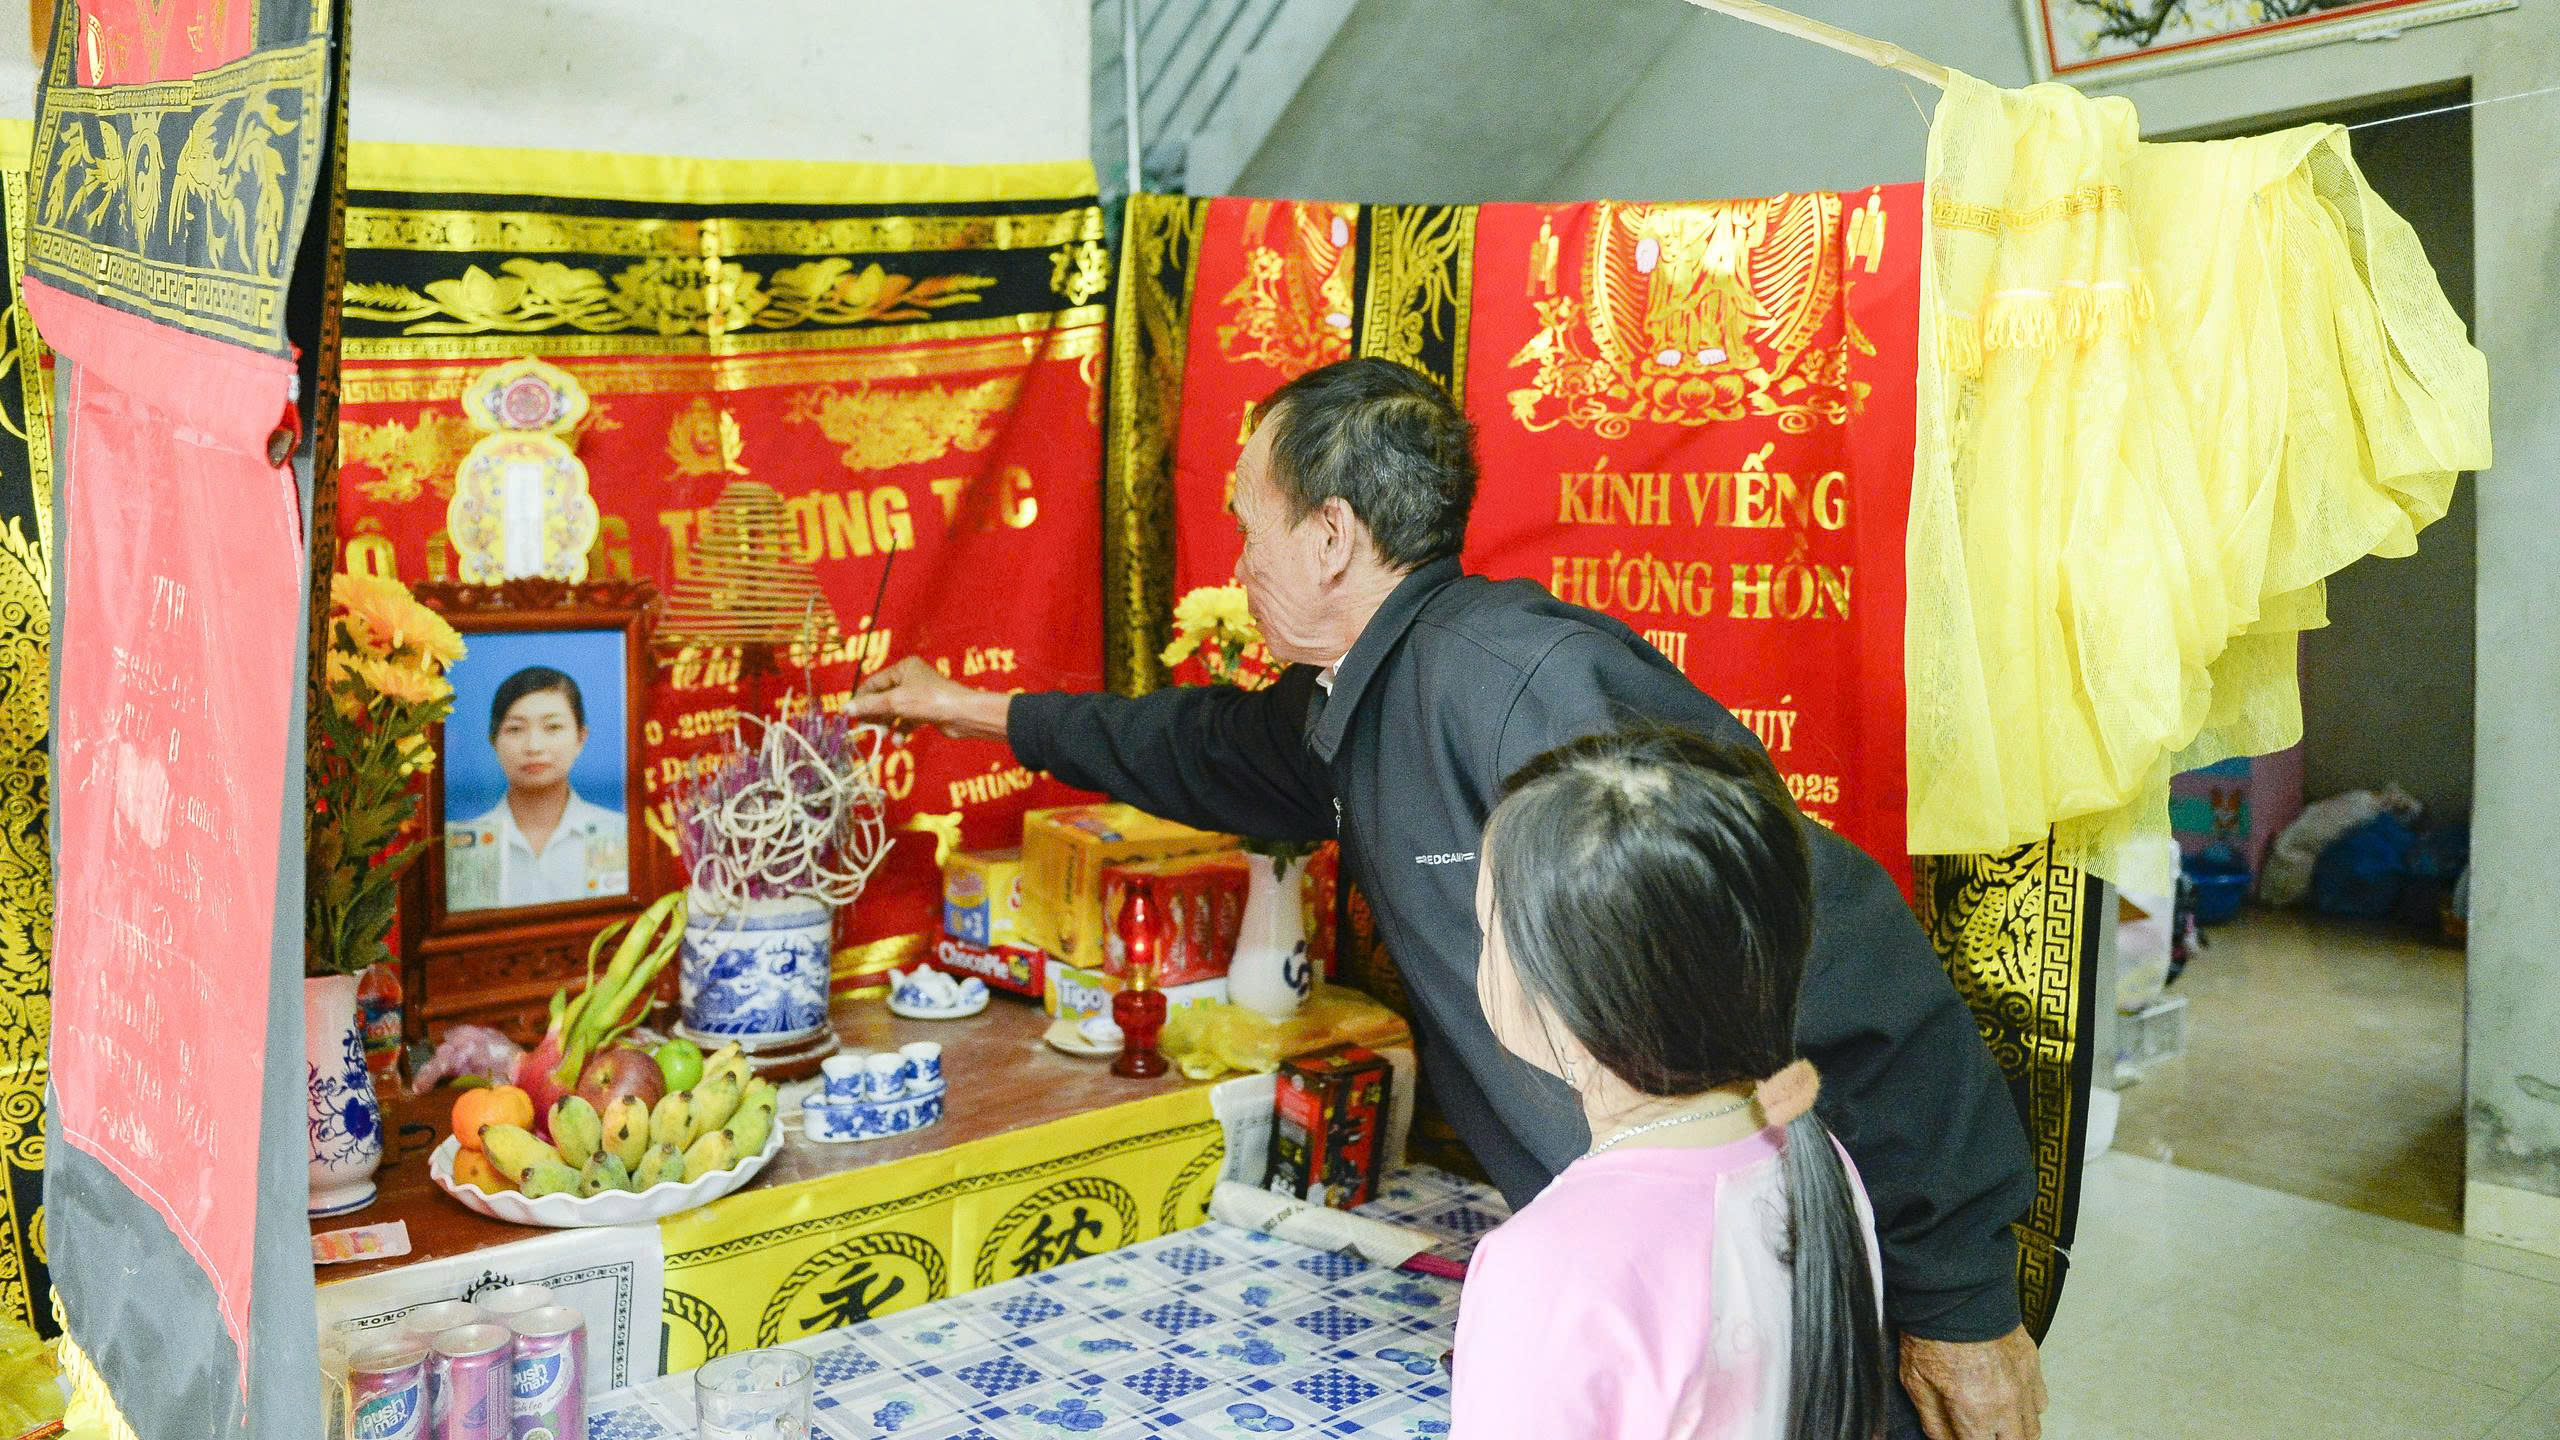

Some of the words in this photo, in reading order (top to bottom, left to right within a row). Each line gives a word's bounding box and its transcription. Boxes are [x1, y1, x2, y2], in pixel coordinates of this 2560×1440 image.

[1557, 455, 1672, 527] KÍNH
[1683, 441, 1848, 531] VIẾNG
[1550, 550, 1714, 618] HƯƠNG
[1728, 532, 1853, 621] HỒN
